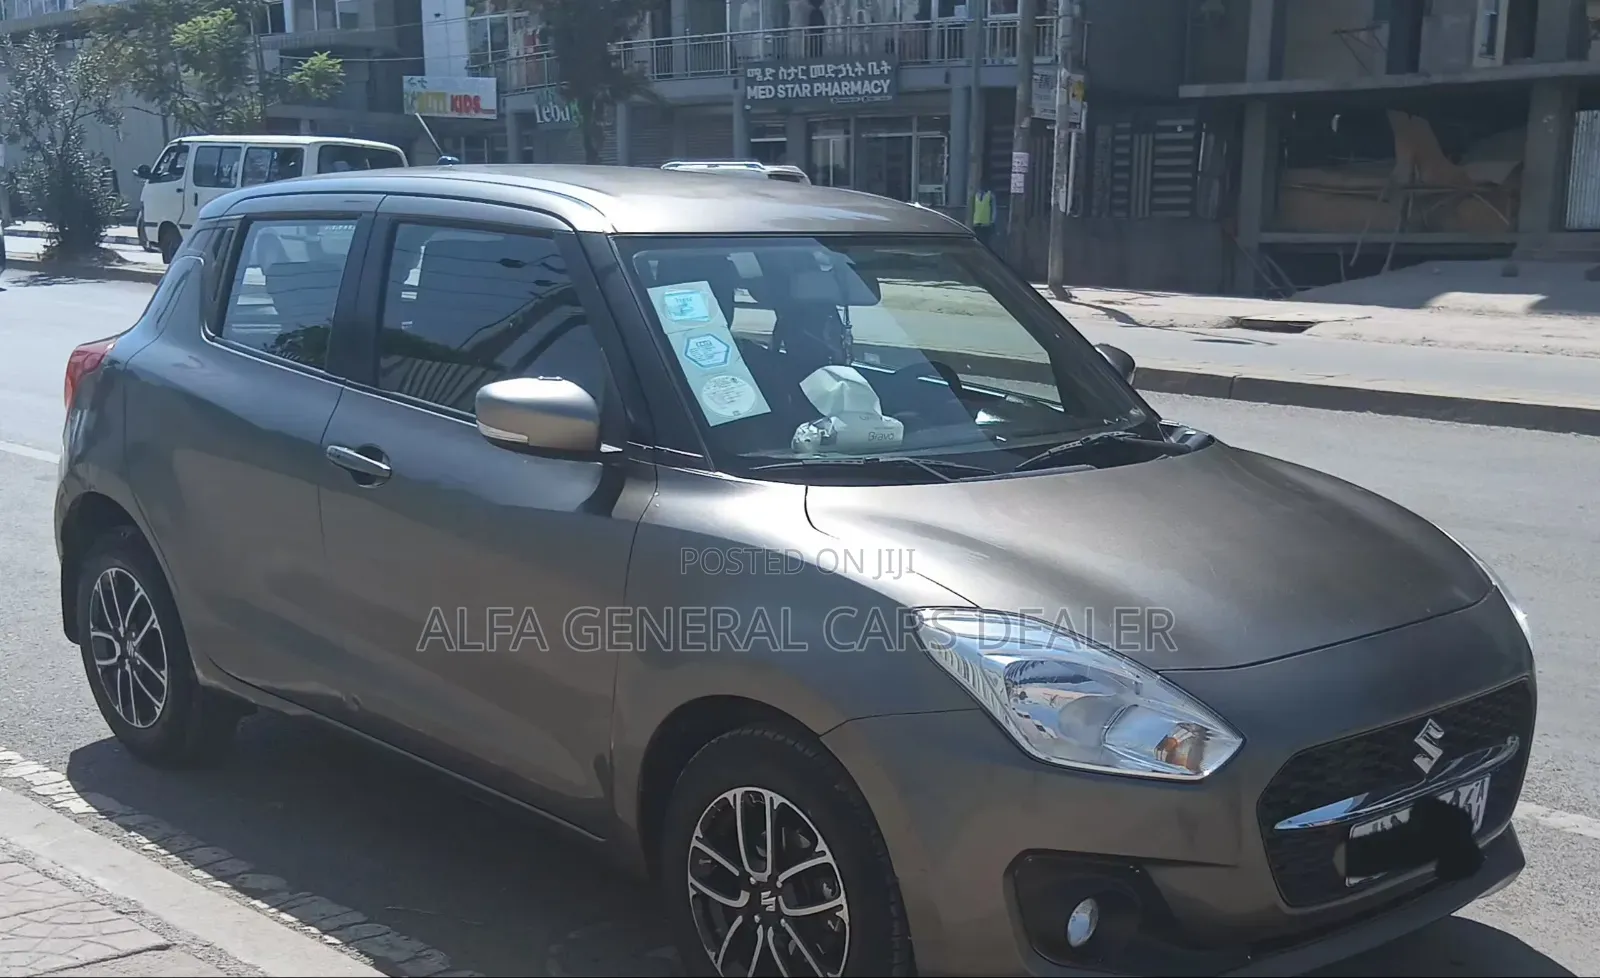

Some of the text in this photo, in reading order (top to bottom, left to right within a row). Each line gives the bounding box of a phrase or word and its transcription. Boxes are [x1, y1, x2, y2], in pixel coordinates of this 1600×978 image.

[746, 78, 891, 100] MED STAR PHARMACY
[450, 94, 481, 114] KIDS
[867, 431, 895, 442] Bravo
